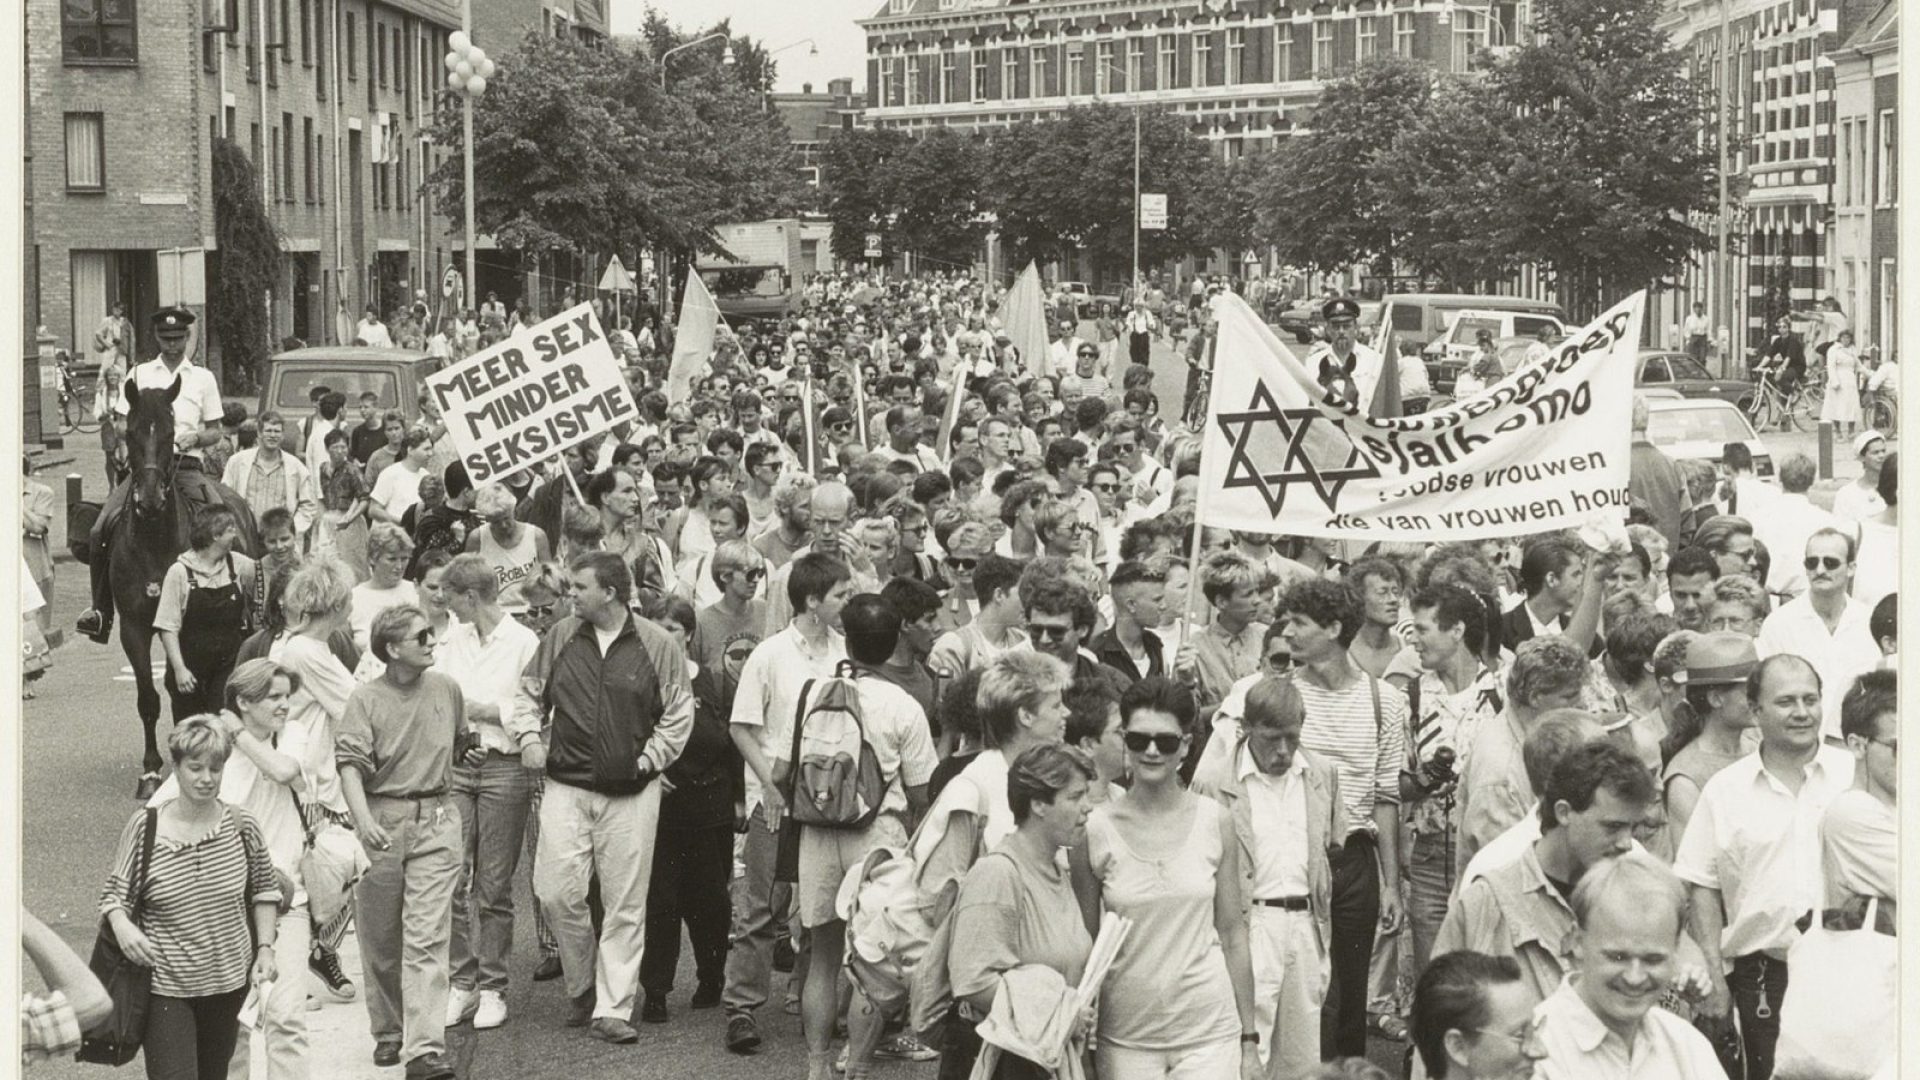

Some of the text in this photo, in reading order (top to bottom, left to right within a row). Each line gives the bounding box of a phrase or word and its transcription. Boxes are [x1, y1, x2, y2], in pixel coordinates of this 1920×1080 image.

[869, 238, 878, 249] P
[433, 312, 600, 412] MEER SEX
[464, 362, 590, 441] MINDER
[465, 384, 633, 481] SEKSISME
[1484, 451, 1607, 488] vrouwen
[1377, 514, 1432, 531] van
[1438, 498, 1564, 529] vrouwen
